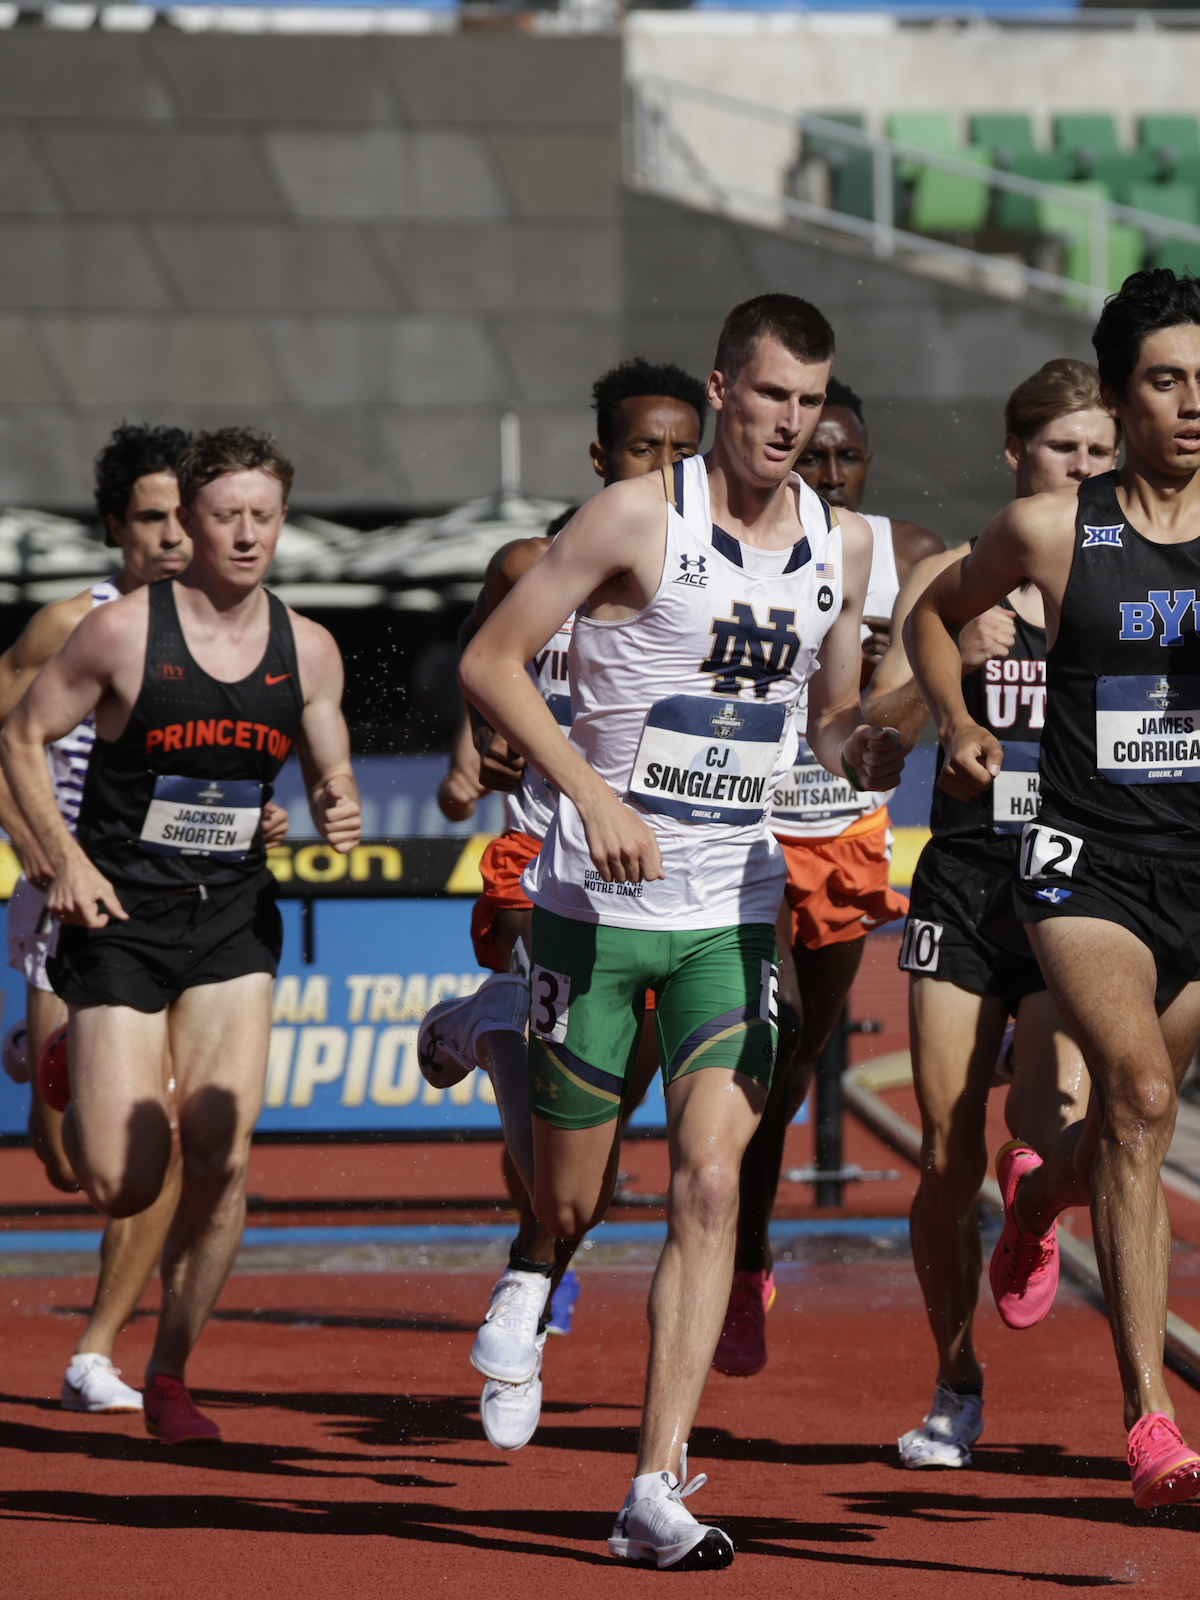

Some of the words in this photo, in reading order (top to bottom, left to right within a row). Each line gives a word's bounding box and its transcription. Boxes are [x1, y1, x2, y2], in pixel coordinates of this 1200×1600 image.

[1085, 526, 1123, 546] XII
[675, 573, 710, 586] ACC
[818, 593, 831, 605] AB
[985, 684, 1047, 729] UT
[1137, 717, 1195, 735] JAMES
[145, 718, 292, 762] PRINCETON
[705, 746, 730, 768] CJ
[643, 762, 766, 803] SINGLETON
[1148, 770, 1172, 778] EUGENE,
[773, 786, 858, 806] SHITSAMA
[174, 808, 236, 826] JACKSON
[162, 824, 237, 846] SHORTEN
[1024, 828, 1073, 876] 12
[583, 879, 614, 894] NOTRE
[616, 884, 643, 898] DAME
[904, 924, 936, 967] 10
[536, 971, 559, 1034] 3
